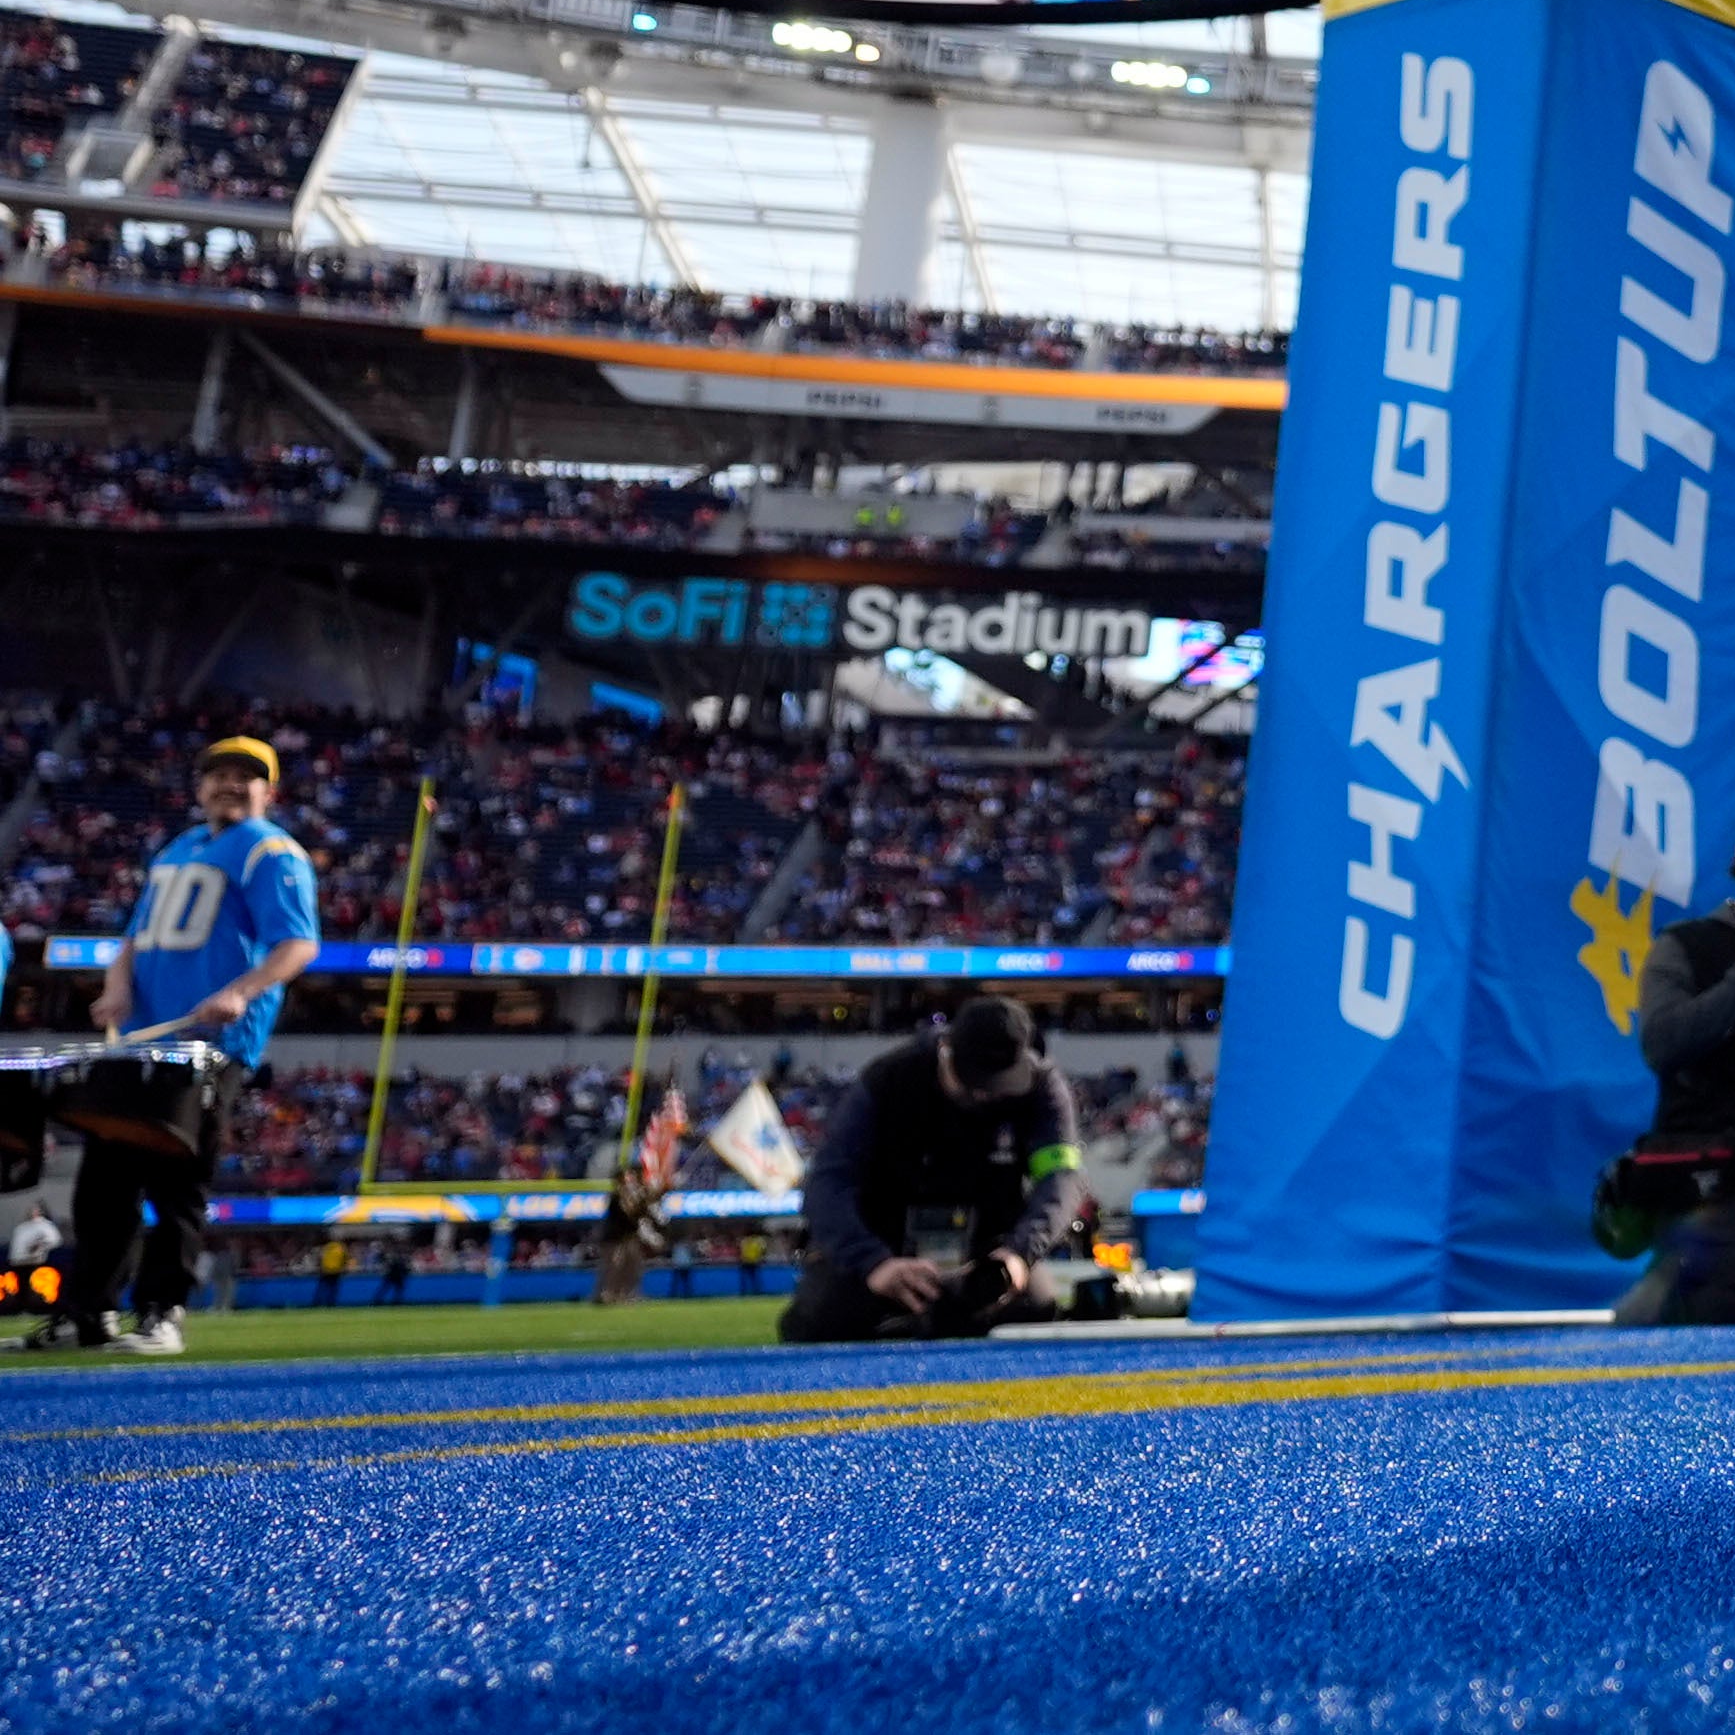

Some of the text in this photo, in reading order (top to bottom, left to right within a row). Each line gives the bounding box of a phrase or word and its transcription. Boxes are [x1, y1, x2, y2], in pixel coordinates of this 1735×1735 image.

[571, 571, 1151, 657] SoFi Stadium
[1339, 53, 1472, 1042] CHARGERS
